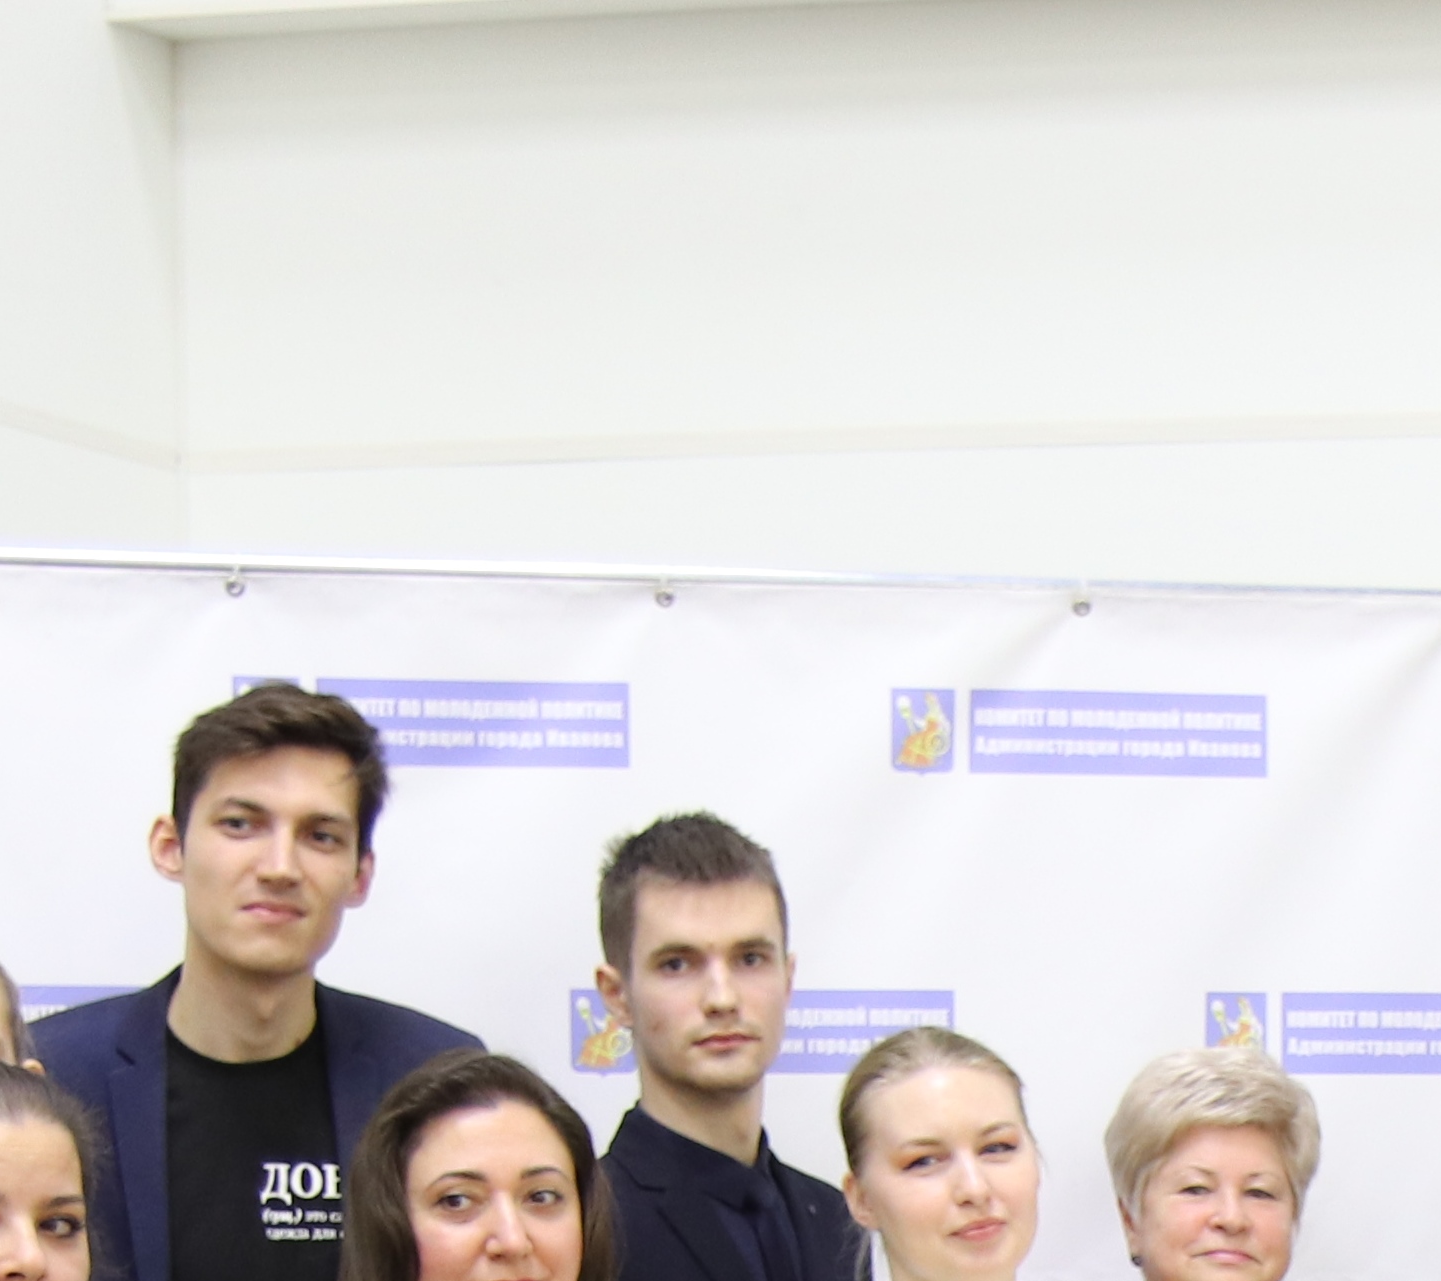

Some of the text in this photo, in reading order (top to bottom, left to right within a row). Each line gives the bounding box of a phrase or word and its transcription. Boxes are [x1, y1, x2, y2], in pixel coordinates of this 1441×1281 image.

[398, 698, 422, 718] ПО
[974, 707, 1045, 727] КОМИТЕТ
[1047, 708, 1069, 728] ПО
[478, 730, 544, 750] города
[546, 728, 624, 749] Иванова
[1121, 740, 1186, 759] города
[1187, 738, 1263, 758] Иванова
[1357, 1010, 1379, 1029] ПО
